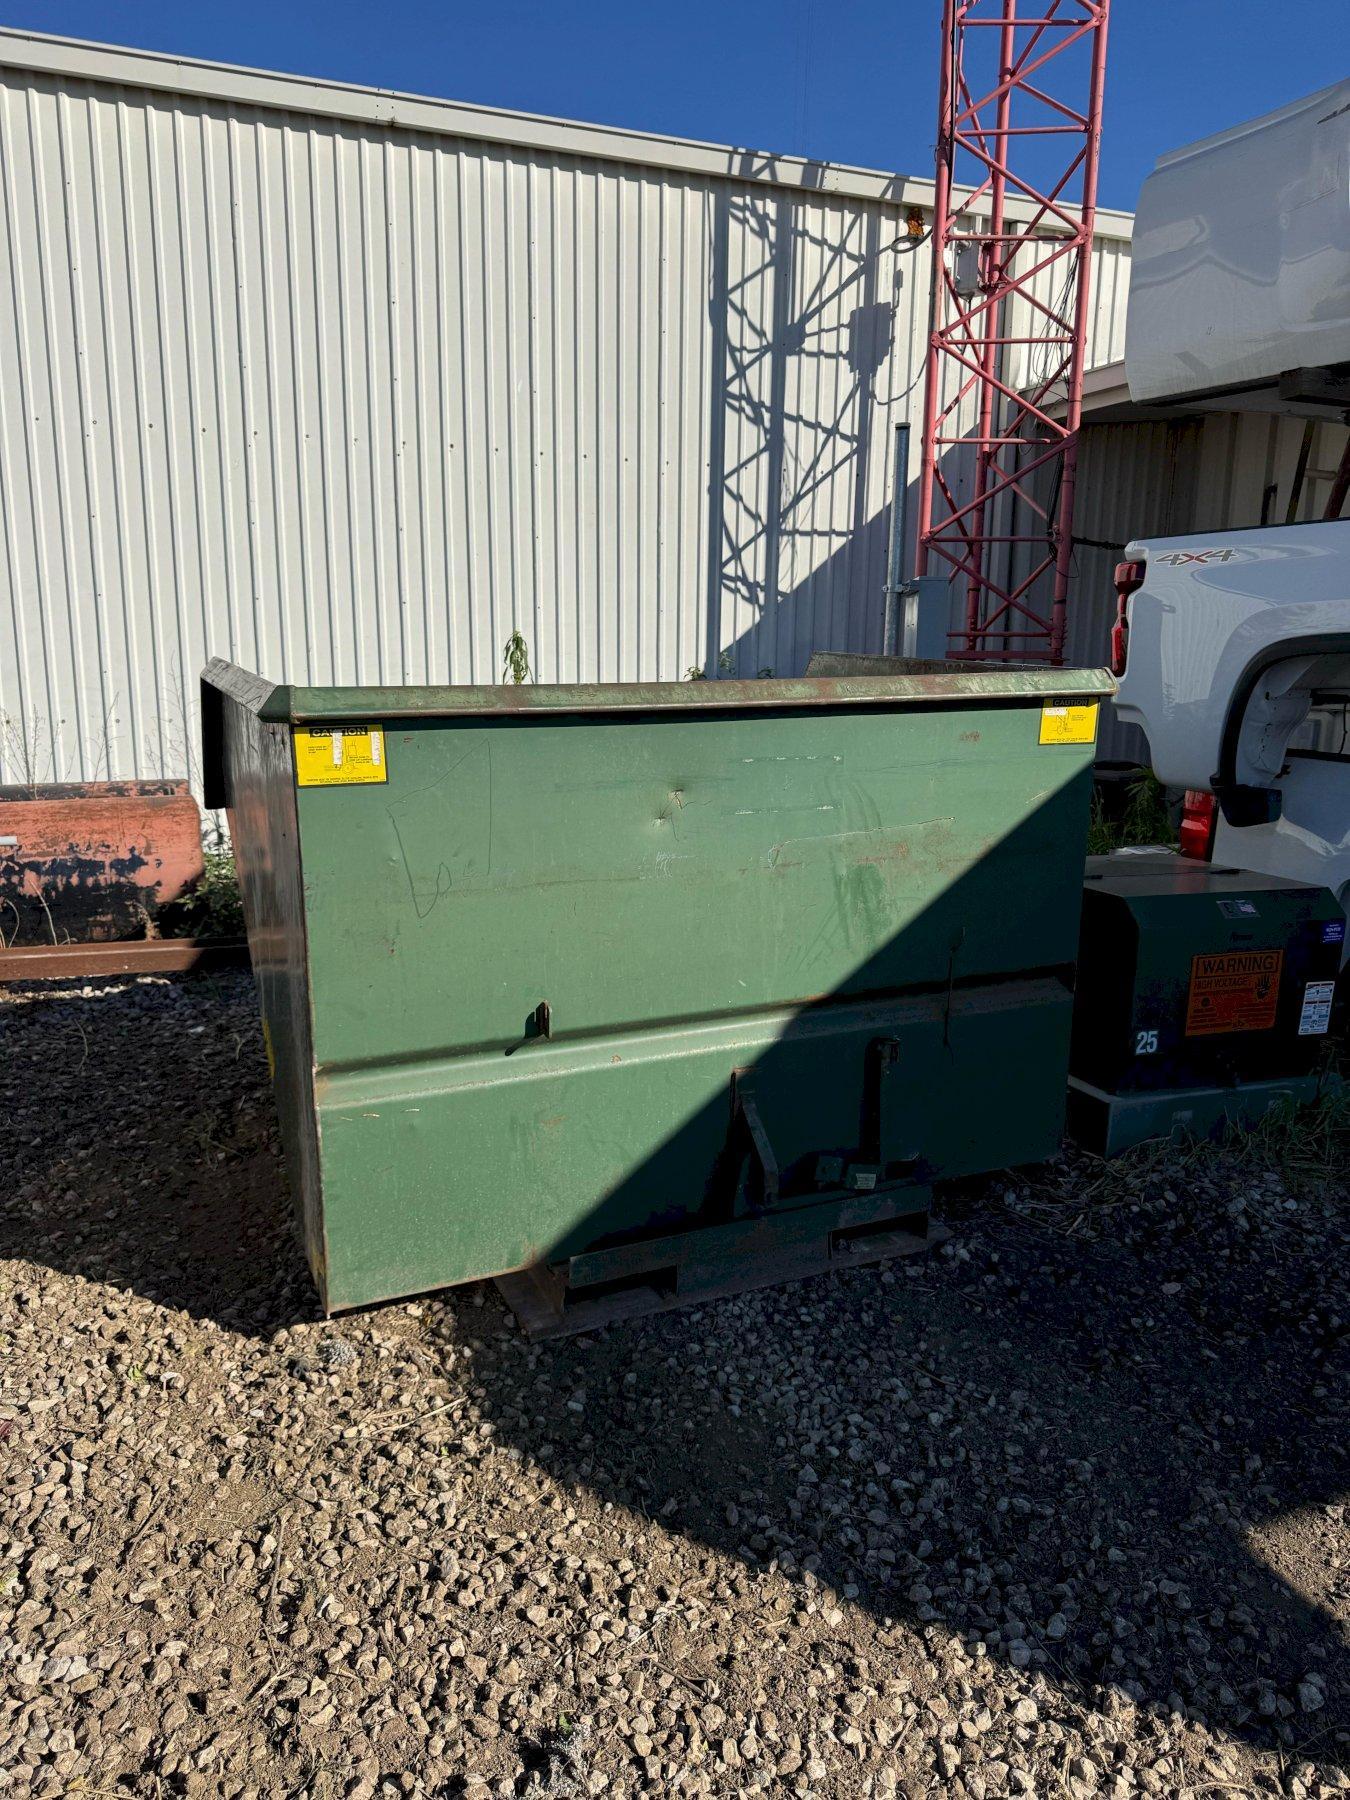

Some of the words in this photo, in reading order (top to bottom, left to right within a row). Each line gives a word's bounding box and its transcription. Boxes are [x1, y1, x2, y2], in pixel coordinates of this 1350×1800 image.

[312, 727, 366, 737] CAION
[1202, 955, 1275, 974] WARNING
[1194, 979, 1214, 990] HIGH
[1214, 976, 1248, 988] VOLTAGE
[1135, 1030, 1159, 1054] 25
